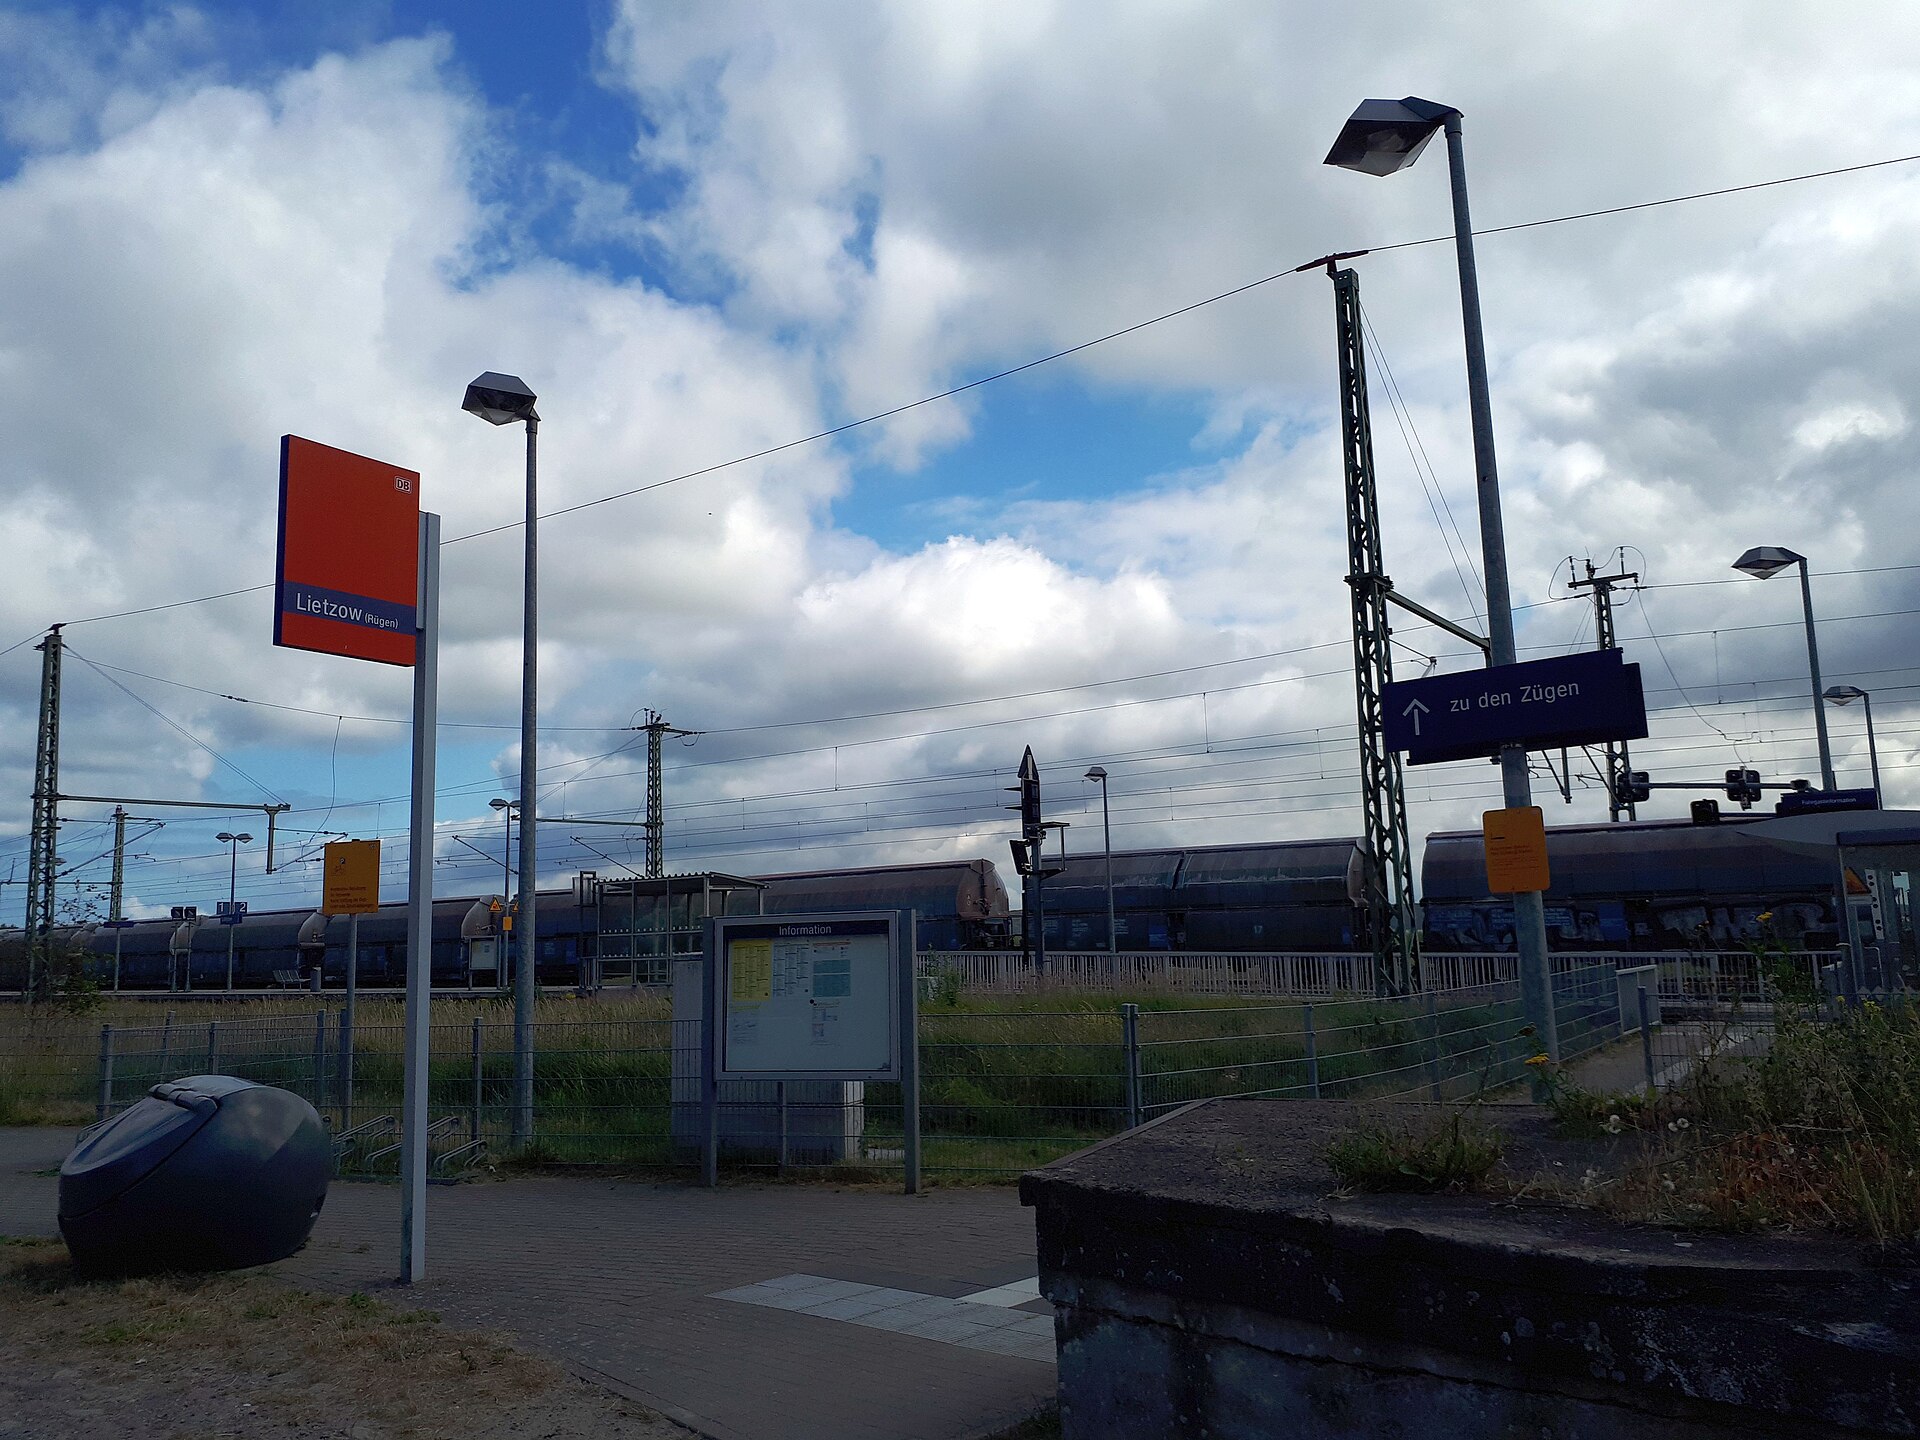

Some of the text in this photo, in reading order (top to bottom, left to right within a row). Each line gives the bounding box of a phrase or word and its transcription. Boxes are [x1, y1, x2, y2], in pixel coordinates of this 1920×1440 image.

[396, 478, 411, 491] DB
[296, 592, 399, 629] Lietzow (Rügen)
[1450, 682, 1580, 712] zu den Zügen
[218, 902, 224, 912] 1
[239, 902, 246, 913] 2
[779, 924, 832, 936] Information
[1253, 925, 1264, 934] 17
